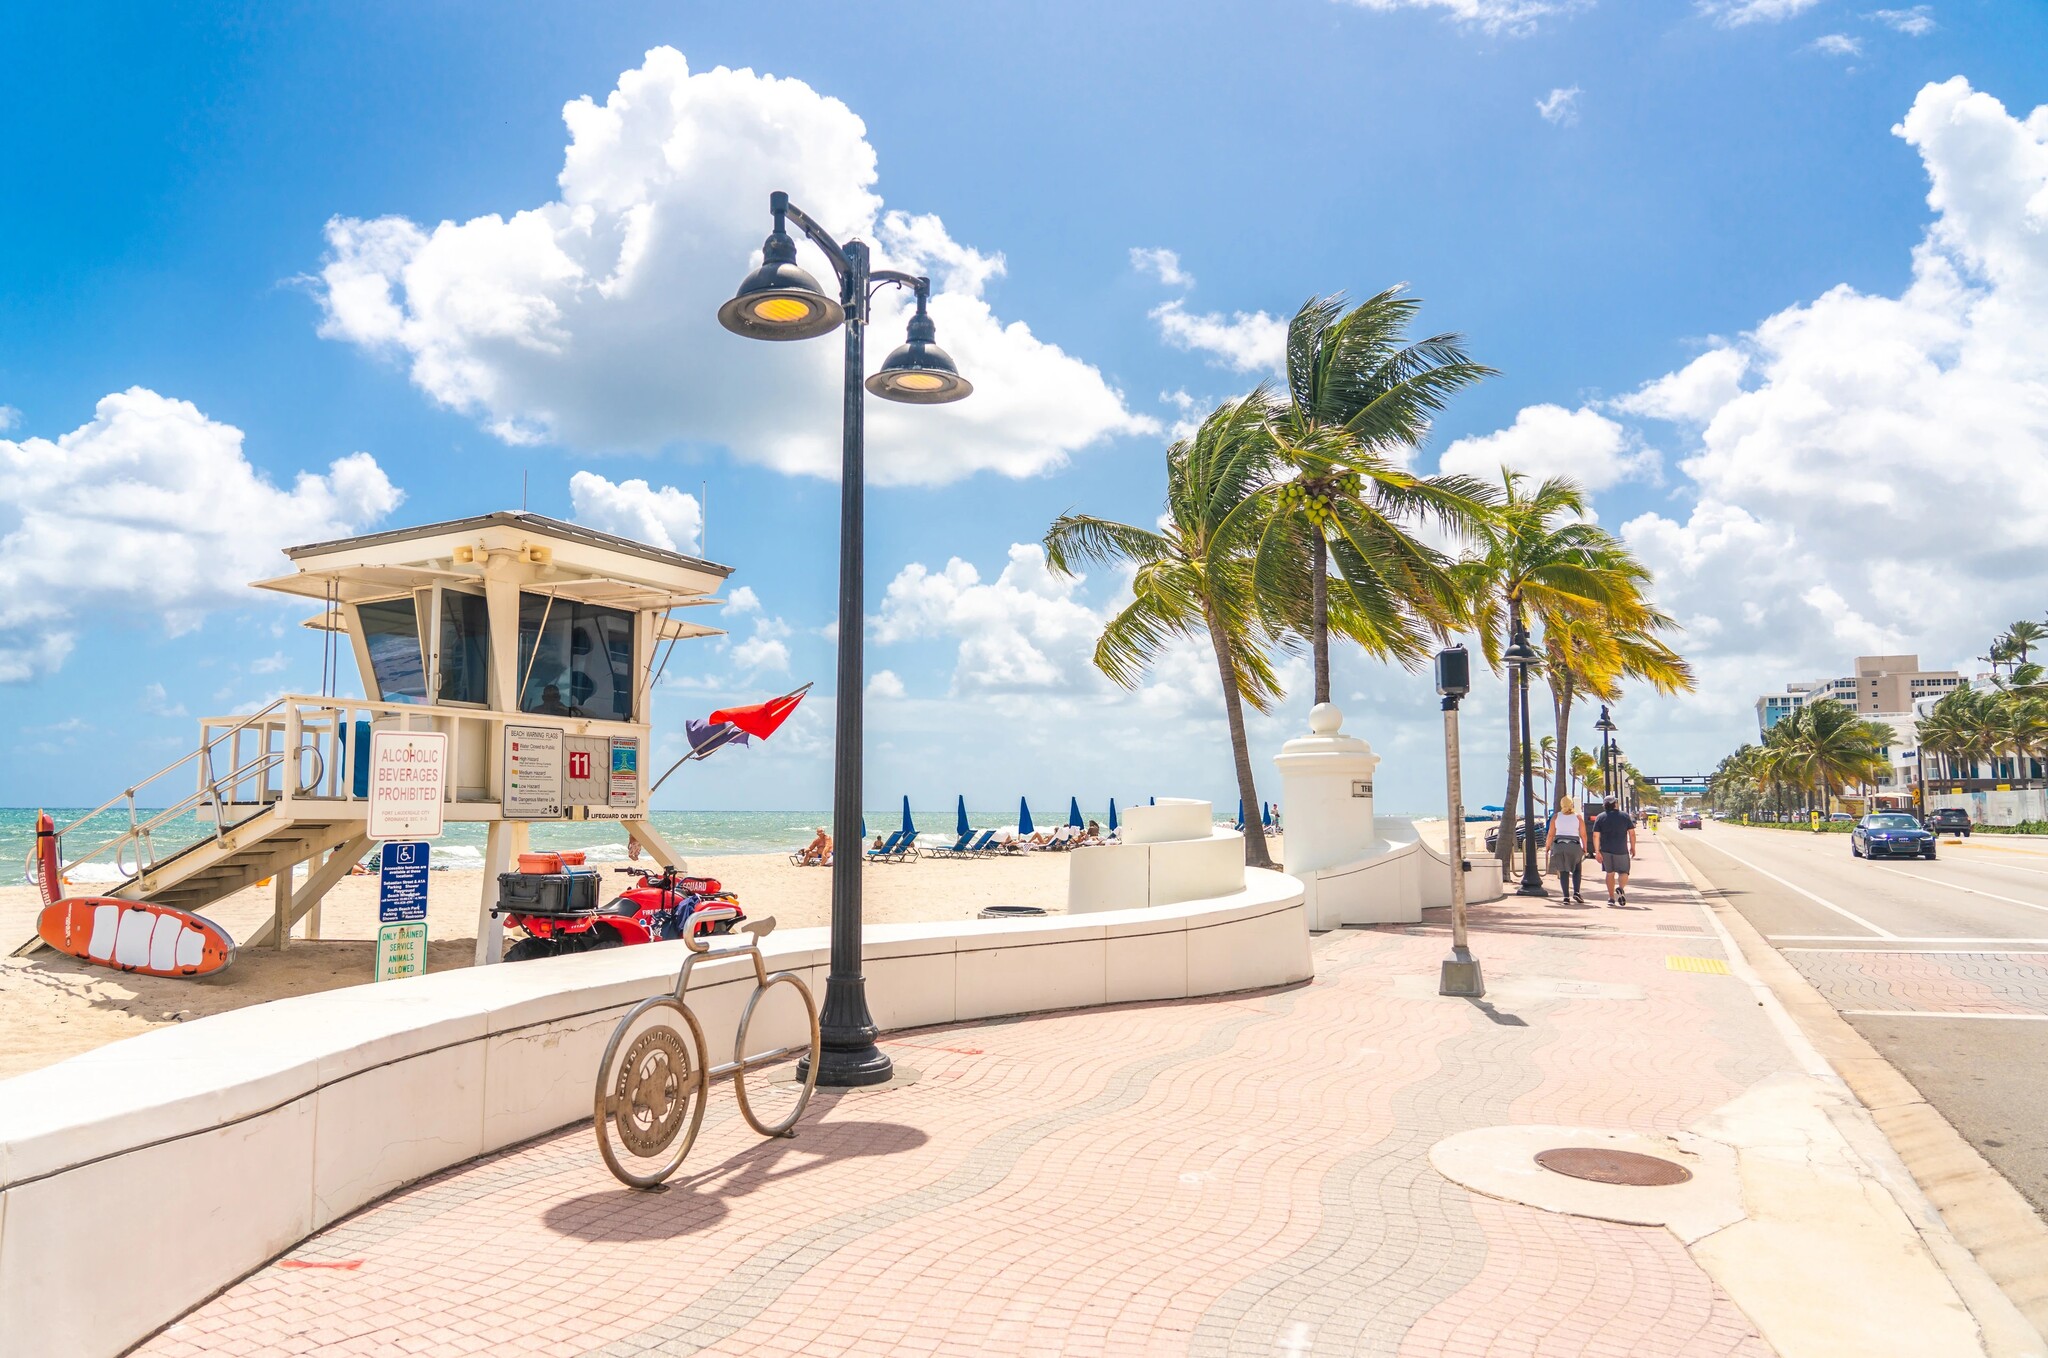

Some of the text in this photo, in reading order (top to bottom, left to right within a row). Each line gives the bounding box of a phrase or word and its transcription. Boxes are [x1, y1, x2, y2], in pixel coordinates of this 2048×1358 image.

[381, 748, 438, 763] ALCOHOLIC
[571, 753, 589, 776] 11
[379, 768, 438, 782] BEVERAGES
[378, 787, 437, 801] PROHIBITED
[382, 930, 424, 941] ONLY TRAINED
[389, 941, 414, 952] SERVICE
[388, 953, 414, 963] ANIMALS
[387, 964, 414, 975] ALLOWED
[638, 1031, 663, 1049] YOUR
